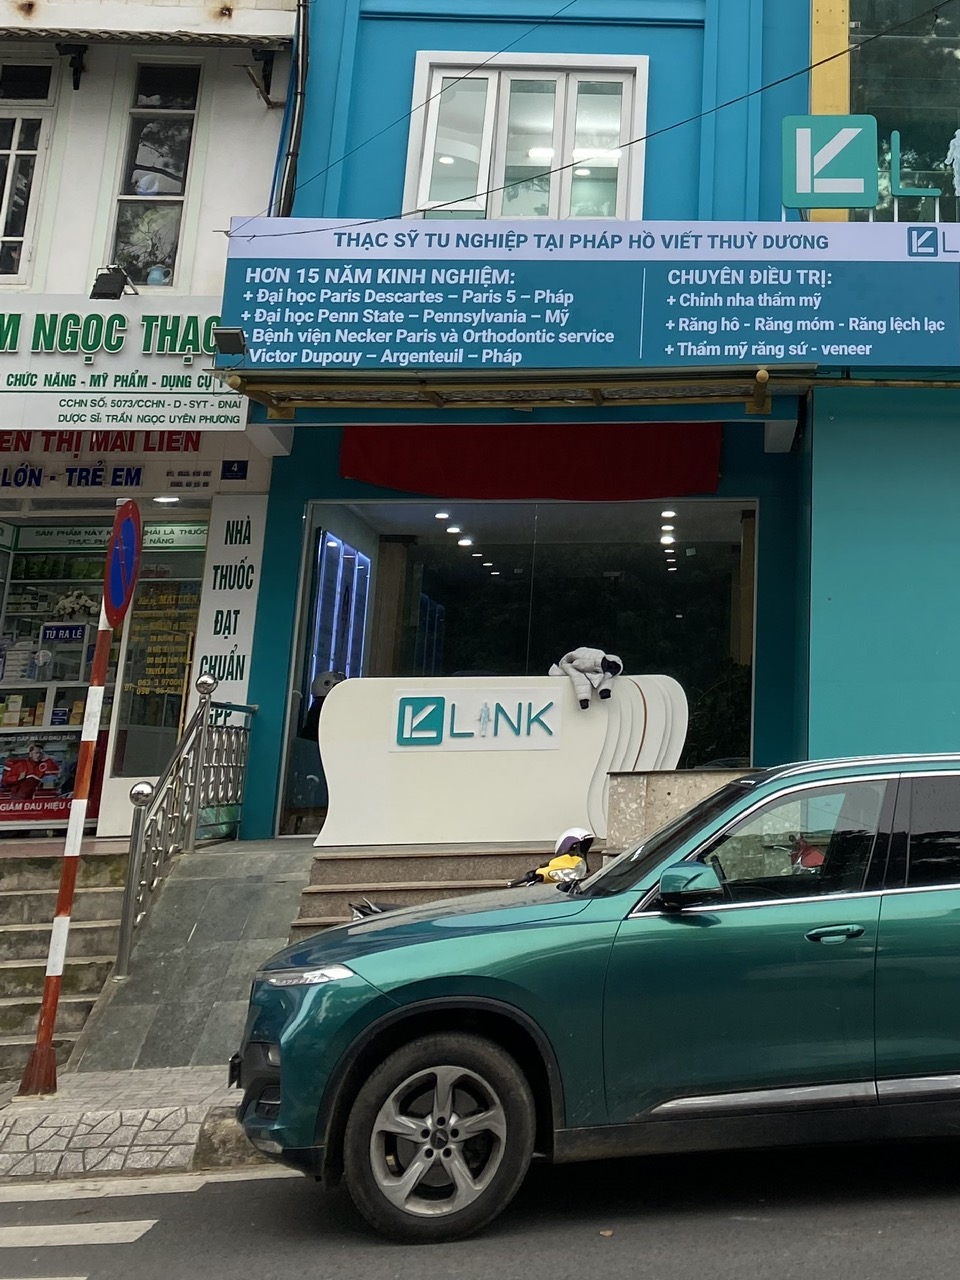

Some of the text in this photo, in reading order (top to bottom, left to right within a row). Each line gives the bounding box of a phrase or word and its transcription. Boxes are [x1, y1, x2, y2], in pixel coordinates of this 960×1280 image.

[334, 230, 829, 251] THẠC SỸ TU NGHIỆP TẠI PHÁP HỒ VIẾT THUỲ DƯƠNG
[245, 265, 515, 287] HƠN 15 NĂM KINH NGHIỆM:
[668, 265, 832, 288] CHUYÊN ĐIỀU TRỊ:
[257, 289, 574, 306] Đại học Paris Descartes Paris 5 Pháp
[679, 291, 822, 309] Chỉnh nha thẩm mỹ
[254, 308, 570, 326] Đại học Penn State Pennsylvania Mỹ
[679, 317, 945, 334] Răng hô Răng móm Răng lệch lạc
[31, 313, 127, 363] NGỌC
[252, 328, 615, 345] Bệnh viện Necker Paris và Orthodontic service
[249, 348, 522, 366] Victor Dupouy Argenteuil Pháp
[677, 341, 872, 359] Thẩm mỹ răng sứ veneer
[6, 371, 38, 386] CHỨC
[43, 372, 76, 387] NĂNG
[89, 372, 108, 387] MỸ
[113, 370, 148, 388] PHẨM
[161, 375, 192, 390] DỤNG
[197, 375, 212, 390] CỤ
[59, 399, 87, 407] CCHN
[173, 400, 181, 408] D
[189, 400, 208, 408] SYT
[137, 414, 165, 425] NGỌC
[169, 412, 195, 423] UYÊN
[199, 414, 240, 423] PHƯƠNG
[41, 431, 135, 458] THỊ MAI
[1, 460, 142, 487] LỚN TRẺ EM
[232, 463, 238, 472] 4
[224, 515, 251, 545] NHÀ
[212, 556, 254, 590] THUỐC
[59, 630, 69, 638] RA
[213, 610, 240, 639] ĐẠT
[199, 644, 246, 681] CHUẨN
